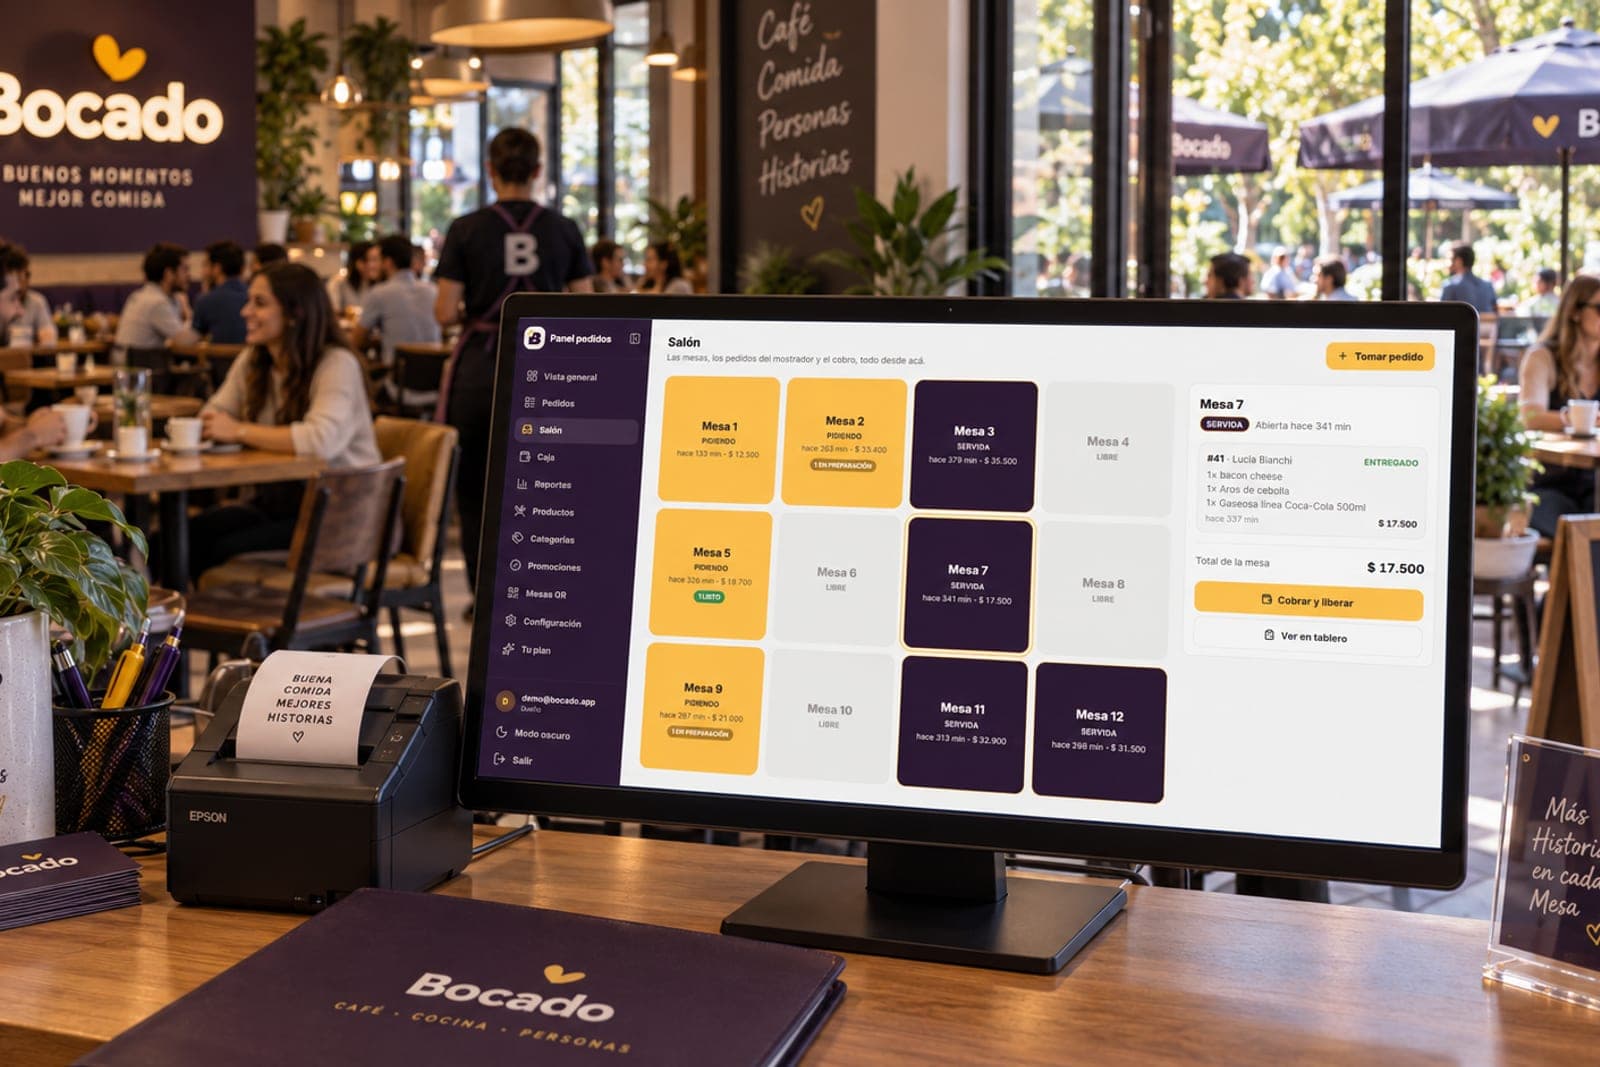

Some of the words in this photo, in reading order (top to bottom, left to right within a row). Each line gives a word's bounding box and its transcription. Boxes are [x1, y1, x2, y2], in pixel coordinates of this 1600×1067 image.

[758, 44, 842, 100] Comida
[759, 102, 851, 148] Personas
[3, 165, 80, 184] BUENOS
[91, 167, 193, 186] MOMENTOS
[759, 150, 851, 196] Historias
[19, 189, 83, 208] MEJOR
[91, 191, 165, 208] COMIDA
[504, 233, 539, 276] B
[550, 334, 574, 343] Panel
[576, 335, 612, 344] pedidos
[668, 337, 700, 347] Salón
[773, 356, 814, 364] mostrador
[816, 357, 821, 365] y
[832, 356, 857, 364] cobro,
[860, 356, 879, 364] todo
[881, 356, 906, 364] desde
[1355, 351, 1386, 362] Tomar
[1389, 352, 1424, 363] pedido
[544, 373, 565, 381] Vista
[566, 373, 597, 382] general
[542, 399, 575, 407] Pedidos
[1200, 399, 1234, 410] Mesa
[1236, 399, 1243, 409] 7
[702, 422, 730, 431] Mesa
[733, 423, 737, 431] 1
[826, 416, 855, 426] Mesa
[858, 417, 864, 426] 2
[1256, 421, 1288, 430] Abierta
[1291, 422, 1313, 431] hace
[1316, 422, 1332, 431] 341
[1335, 423, 1351, 431] min
[539, 426, 562, 434] Salón
[954, 426, 985, 436] Mesa
[987, 427, 995, 436] 3
[1087, 436, 1119, 447] Mesa
[1121, 437, 1129, 447] 4
[537, 454, 555, 462] Caja
[1207, 455, 1225, 463] #41
[1232, 455, 1257, 464] Lucía
[1259, 456, 1292, 465] Bianchi
[1207, 471, 1216, 479] 1x
[1220, 472, 1247, 480] bacon
[1250, 472, 1282, 481] cheese
[534, 481, 572, 490] Reportes
[1207, 485, 1216, 493] 1x
[1220, 486, 1240, 494] Aros
[1243, 486, 1254, 494] de
[1257, 487, 1289, 495] cebolla
[1206, 499, 1216, 507] 1x
[1219, 499, 1258, 508] Gaseosa
[1285, 501, 1334, 511] Coca-Cola
[1337, 502, 1366, 512] 500ml
[532, 508, 574, 517] Productos
[1244, 516, 1258, 524] min
[1378, 520, 1384, 528] $
[1387, 520, 1417, 529] 17.500
[530, 535, 575, 545] Categorías
[693, 548, 722, 558] Mesa
[724, 548, 731, 558] 5
[528, 562, 581, 572] Promociones
[1196, 556, 1218, 565] Total
[1221, 557, 1232, 566] de
[1234, 558, 1243, 566] la
[1245, 559, 1270, 567] mesa
[817, 567, 847, 577] Mesa
[850, 568, 857, 577] 6
[948, 565, 979, 575] Mesa
[980, 566, 988, 575] 7
[1368, 562, 1375, 573] $
[1380, 563, 1424, 574] 17.500
[1082, 578, 1115, 589] Mesa
[1117, 579, 1125, 589] 8
[1278, 596, 1311, 606] Cobrar
[1314, 600, 1319, 608] y
[1322, 598, 1354, 607] liberar
[524, 617, 582, 628] Configuración
[1281, 632, 1298, 641] Ver
[1314, 634, 1347, 643] tablero
[533, 647, 551, 656] plan
[292, 674, 332, 684] BUENA
[284, 686, 331, 696] COMIDA
[684, 683, 713, 693] Mesa
[716, 684, 723, 694] 9
[276, 699, 331, 710] MEJORES
[808, 703, 837, 714] Mesa
[840, 705, 853, 715] 10
[941, 702, 972, 713] Mesa
[974, 704, 985, 714] 11
[267, 713, 333, 725] HISTORIAS
[1076, 709, 1108, 721] Mesa
[1110, 712, 1124, 722] 12
[515, 729, 539, 738] Modo
[541, 732, 570, 740] oscuro
[1052, 741, 1070, 749] hace
[1118, 745, 1146, 753] 31.500
[513, 756, 532, 765] Salir
[1545, 796, 1589, 826] Más
[189, 811, 227, 823] EPSON
[1532, 865, 1554, 880] en
[1560, 865, 1600, 890] cada
[1529, 889, 1580, 917] Mesa
[405, 972, 614, 1022] Bocado
[334, 1001, 386, 1016] CAFÉ
[411, 1012, 488, 1031] COCINA
[519, 1028, 631, 1054] PERSONAS
